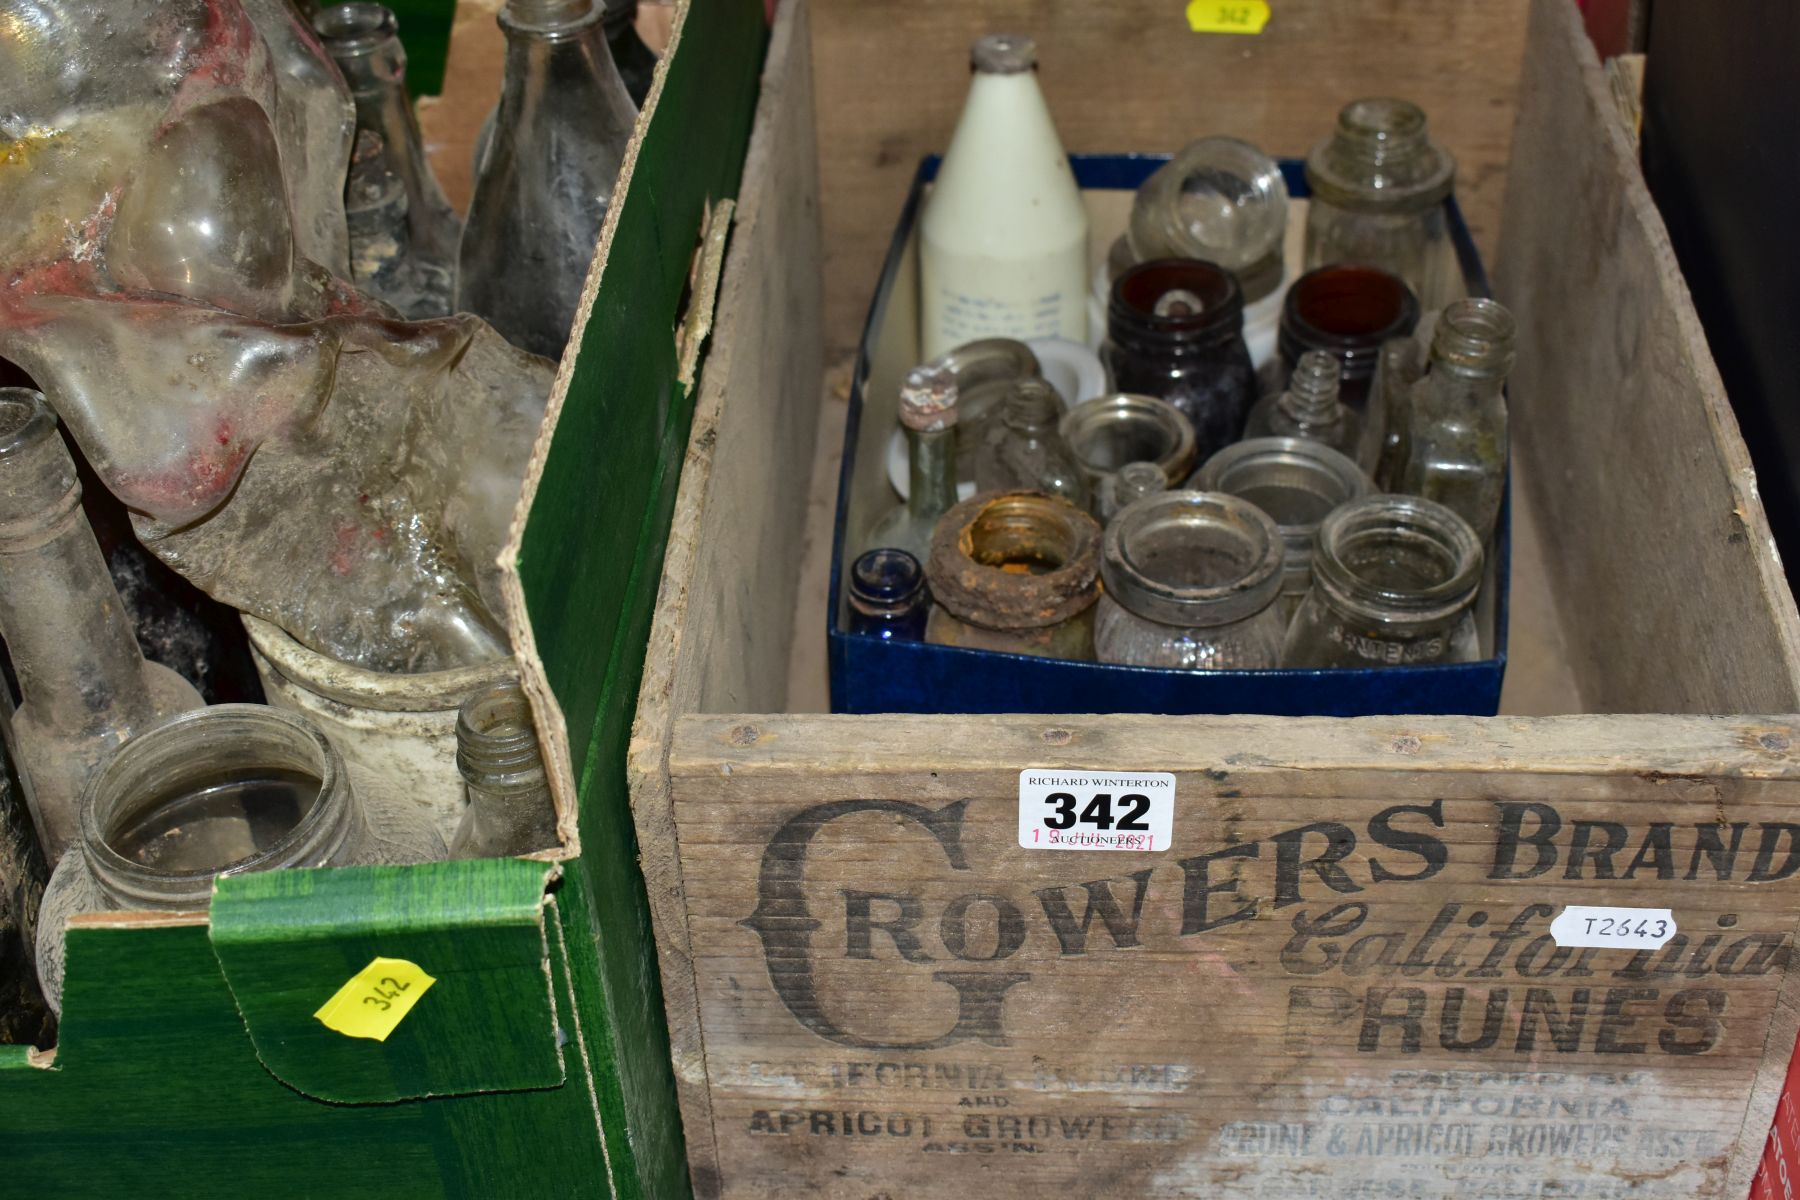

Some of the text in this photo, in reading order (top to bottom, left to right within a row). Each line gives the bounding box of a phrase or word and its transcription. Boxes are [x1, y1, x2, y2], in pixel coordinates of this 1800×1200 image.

[1028, 777, 1169, 788] RICHARD WINTERTON
[1043, 792, 1151, 831] 342
[1052, 835, 1142, 845] AUCTIONEERS
[1486, 801, 1800, 883] BRAND
[1584, 917, 1668, 938] T2643
[362, 976, 412, 1012] 342
[1284, 985, 1730, 1056] PRUNES
[957, 1095, 1010, 1109] AND
[1318, 1094, 1634, 1118] CALIFORNIA
[1325, 1122, 1348, 1157] &
[1355, 1122, 1481, 1157] APRICOT
[1487, 1122, 1632, 1158] GROWERS
